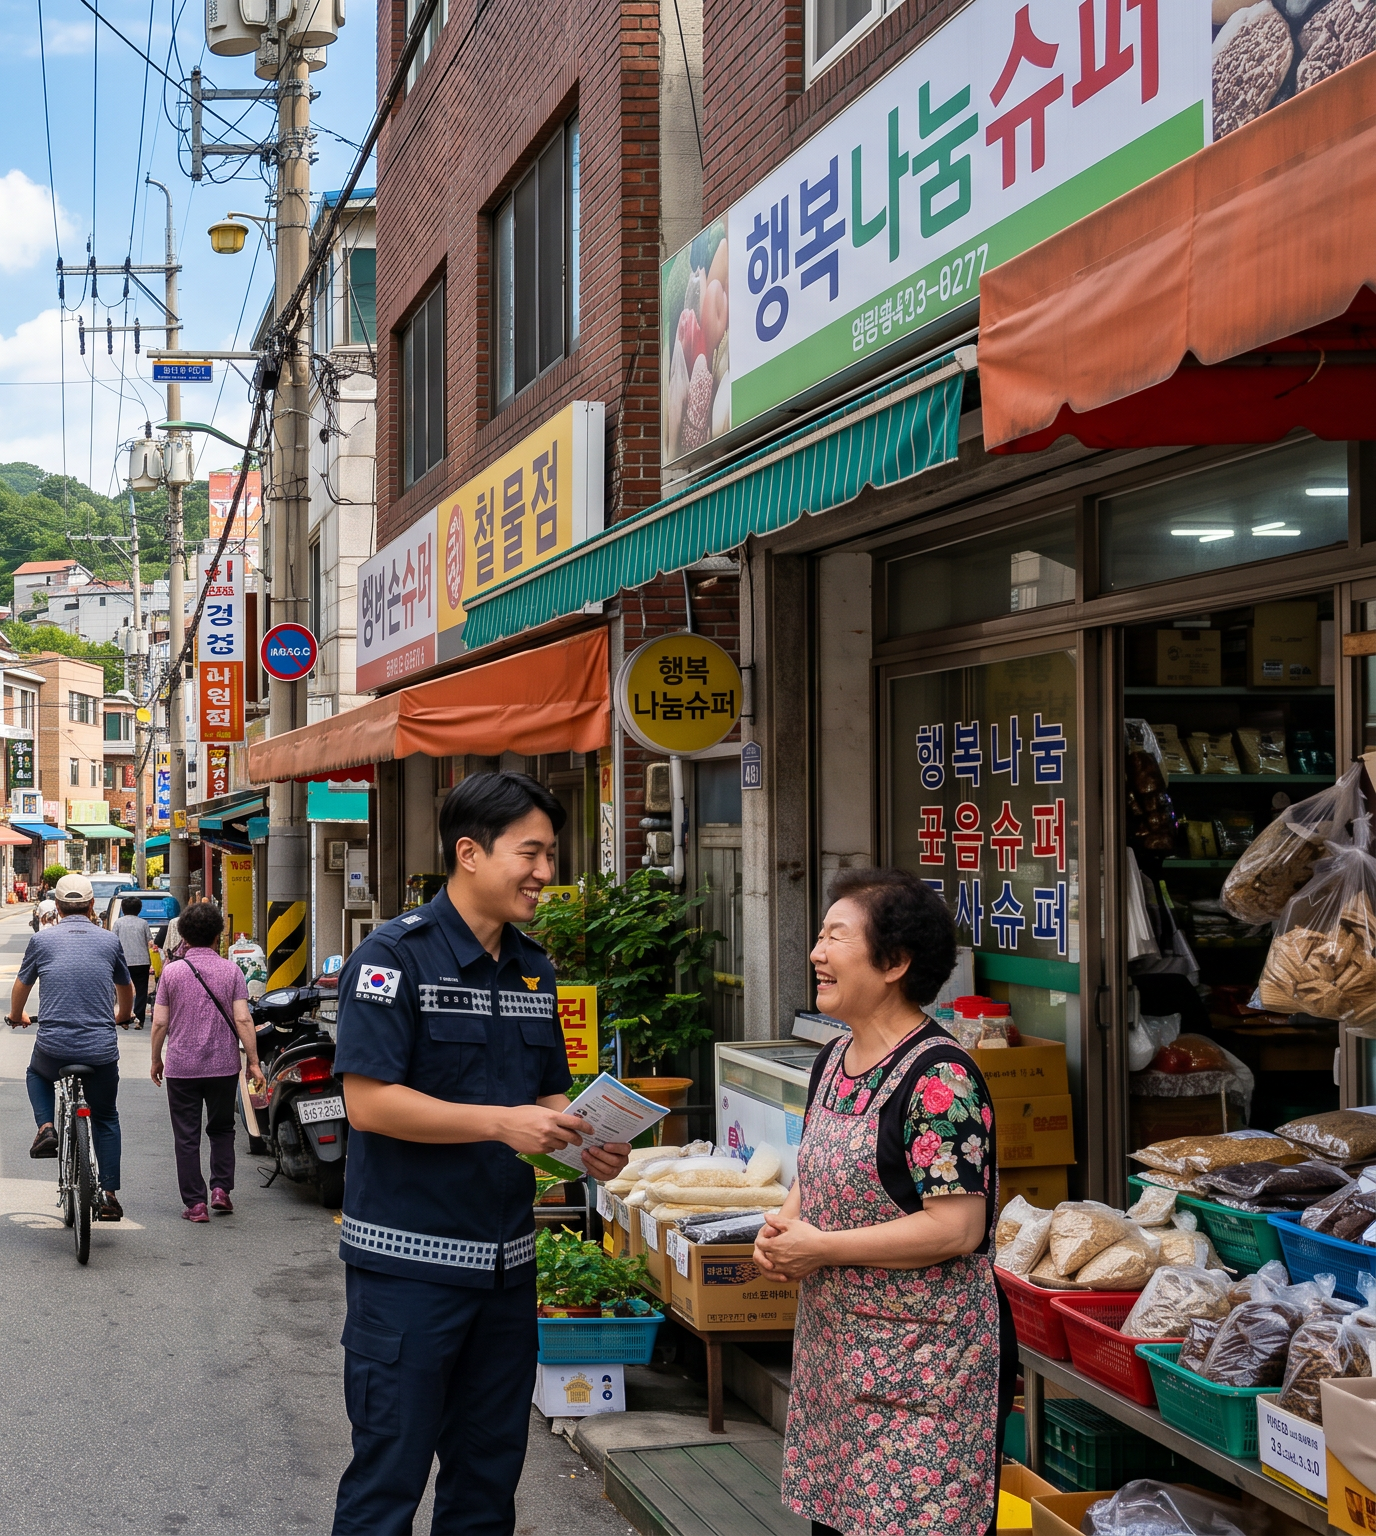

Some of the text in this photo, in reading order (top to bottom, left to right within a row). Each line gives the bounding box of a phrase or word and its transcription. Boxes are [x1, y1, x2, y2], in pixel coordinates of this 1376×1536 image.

[474, 440, 557, 587] 철물점
[658, 656, 710, 686] 행복
[634, 690, 735, 721] 나눔슈퍼
[916, 712, 1067, 790] 행복나눔
